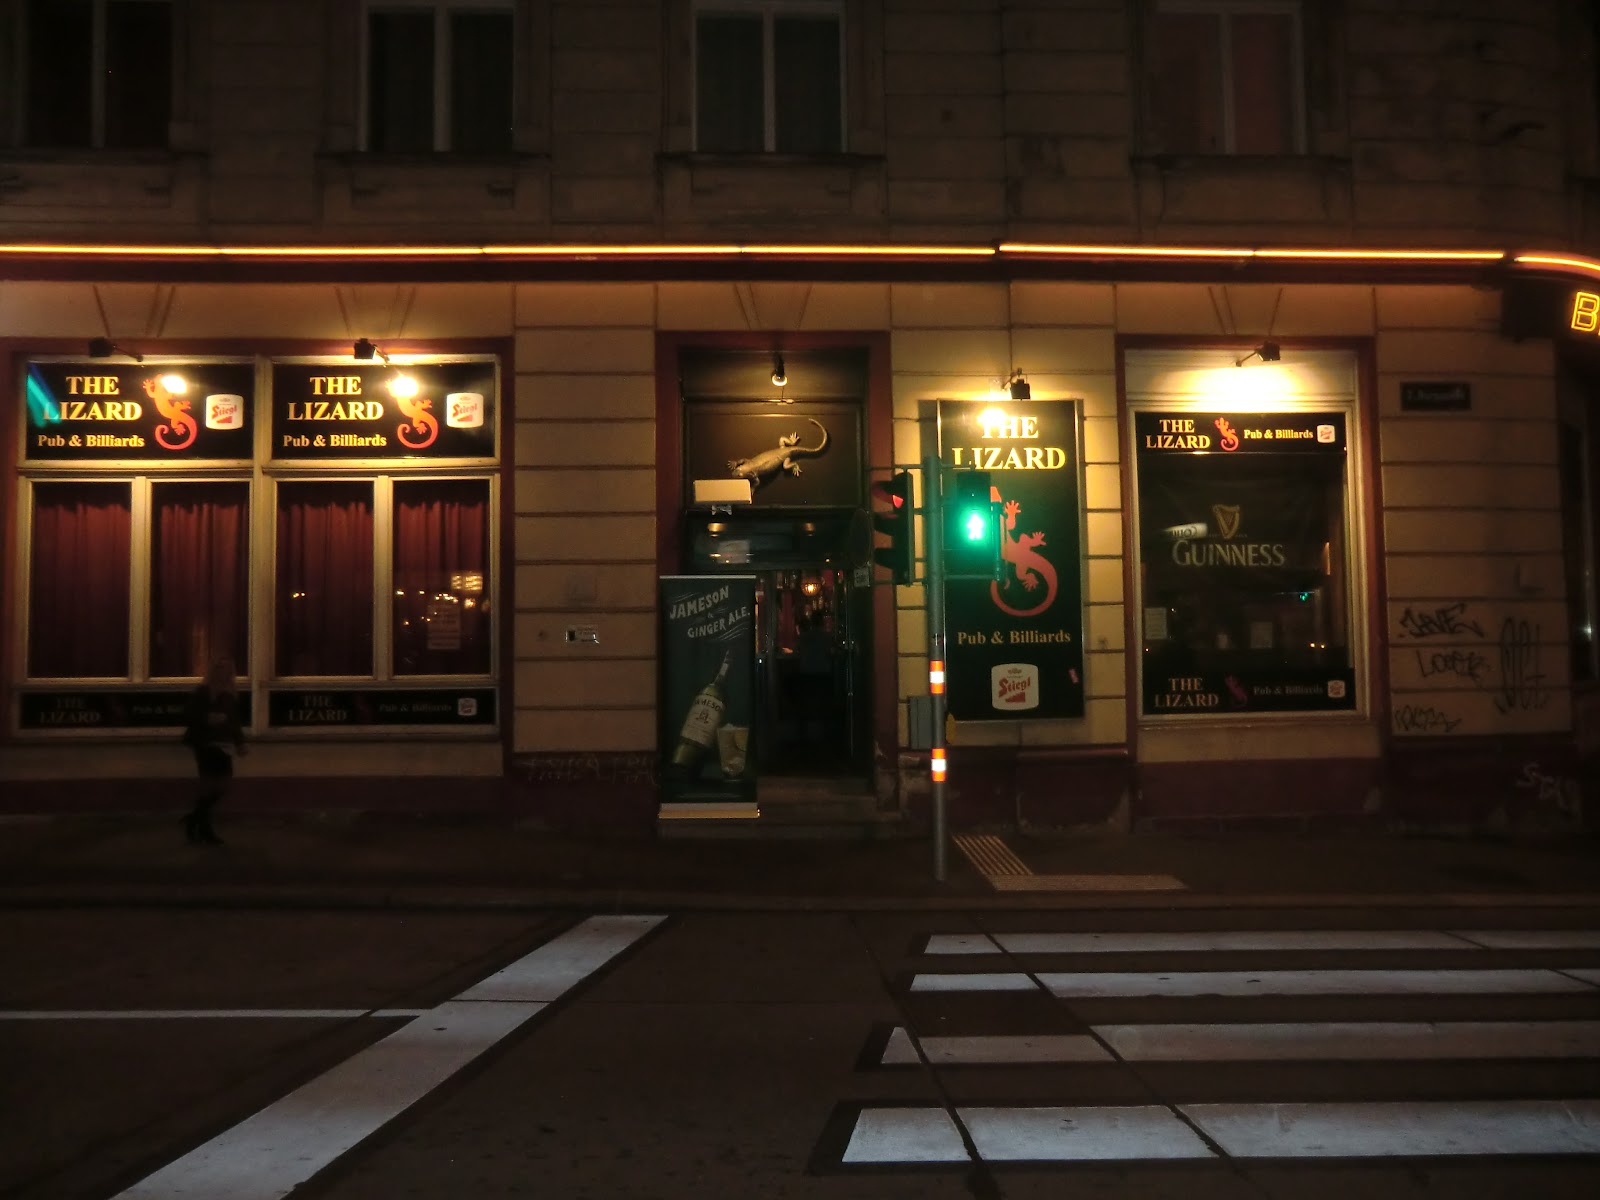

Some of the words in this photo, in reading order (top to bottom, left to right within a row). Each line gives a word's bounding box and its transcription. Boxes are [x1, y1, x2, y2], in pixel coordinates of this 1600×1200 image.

[66, 376, 119, 395] THE
[310, 376, 362, 395] THE
[44, 401, 142, 421] LIZARD
[287, 401, 384, 421] LIZARD
[981, 415, 1039, 439] THE
[1160, 419, 1195, 433] THE
[1243, 429, 1262, 440] Pub
[1264, 429, 1274, 440] &
[1275, 429, 1314, 440] Billiards
[39, 434, 65, 447] Pub
[68, 434, 83, 447] &
[86, 434, 145, 447] Billiards
[283, 434, 309, 447] Pub
[313, 434, 327, 447] &
[330, 433, 387, 447] Billiards
[1146, 434, 1211, 449] LIZARD
[952, 446, 1066, 470] LIZARD
[1172, 540, 1286, 567] GUINNESS
[669, 585, 729, 619] JAMESON
[687, 618, 727, 638] GINGER
[728, 606, 750, 625] ALE.
[957, 631, 986, 645] Pub
[990, 630, 1005, 644] &
[1010, 629, 1071, 643] Billiards
[998, 677, 1031, 698] Stiegl
[1168, 677, 1203, 691] THE
[1154, 693, 1219, 708] LIZARD
[288, 708, 348, 722] LIZARD
